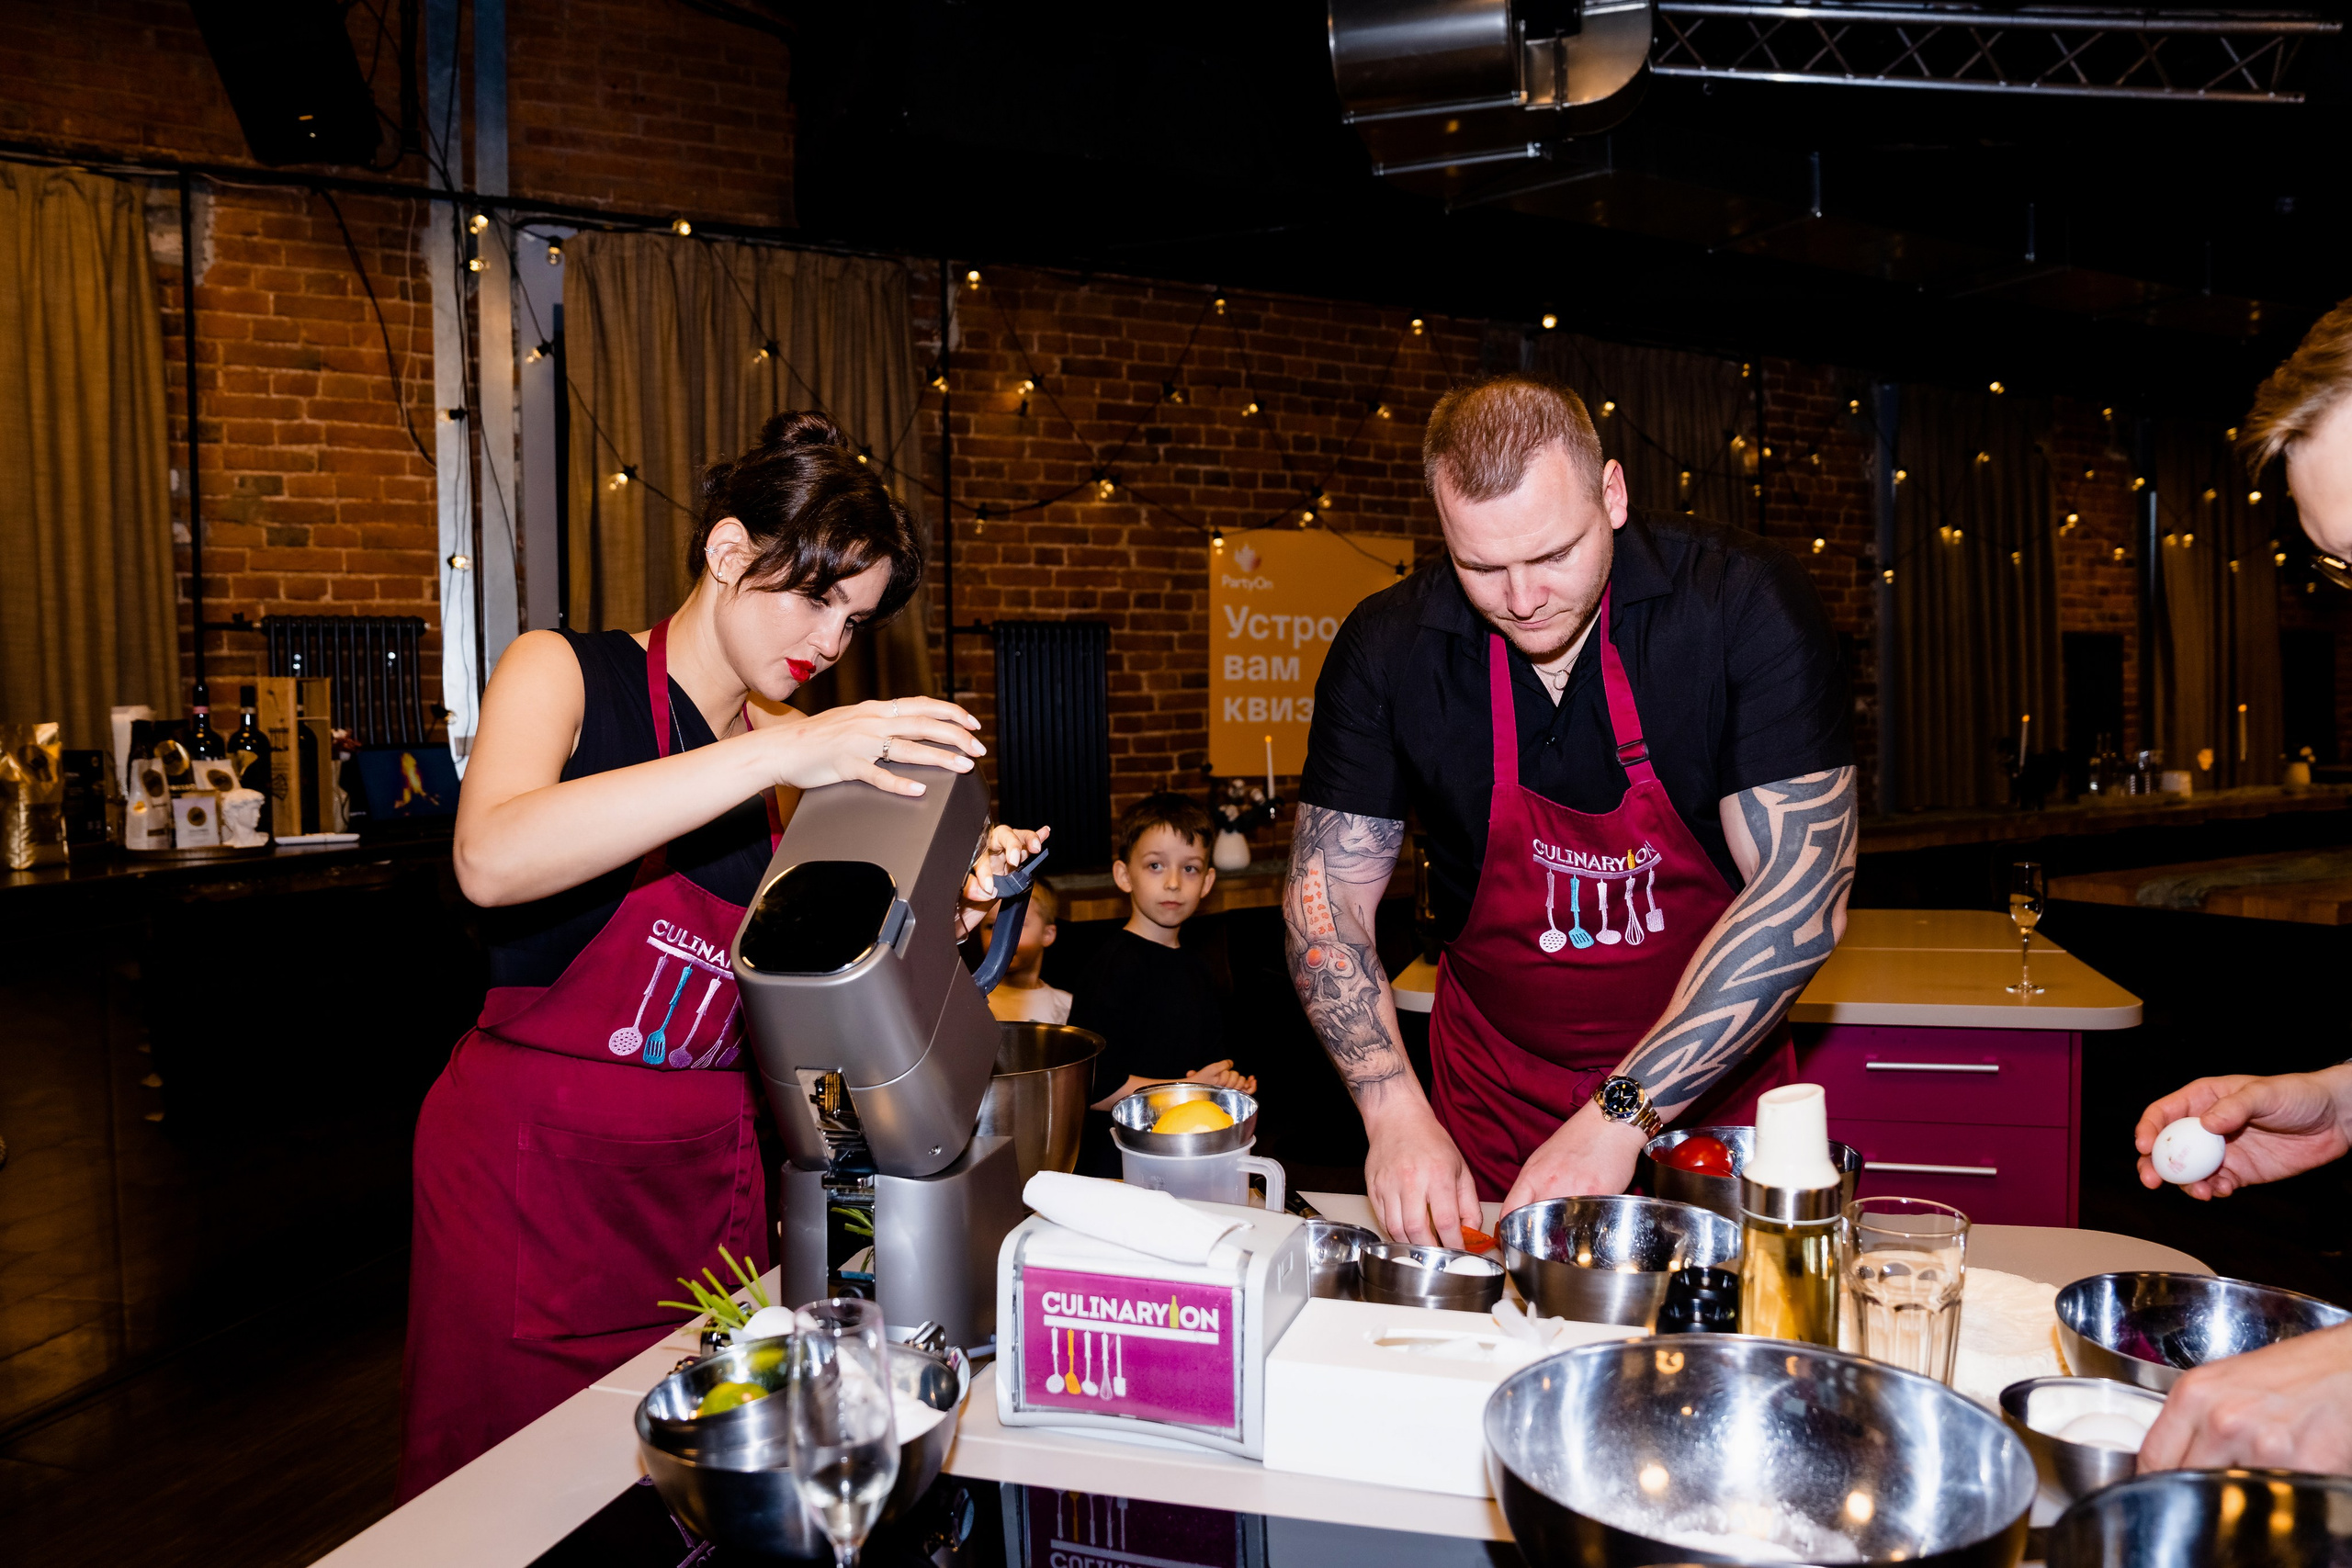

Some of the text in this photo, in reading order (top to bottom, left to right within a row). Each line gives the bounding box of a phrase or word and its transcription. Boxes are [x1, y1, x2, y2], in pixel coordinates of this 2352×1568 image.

[1222, 575, 1273, 591] PartyOn
[1223, 604, 1345, 649] Устро
[1223, 655, 1300, 682] вам
[1223, 696, 1314, 723] квиз
